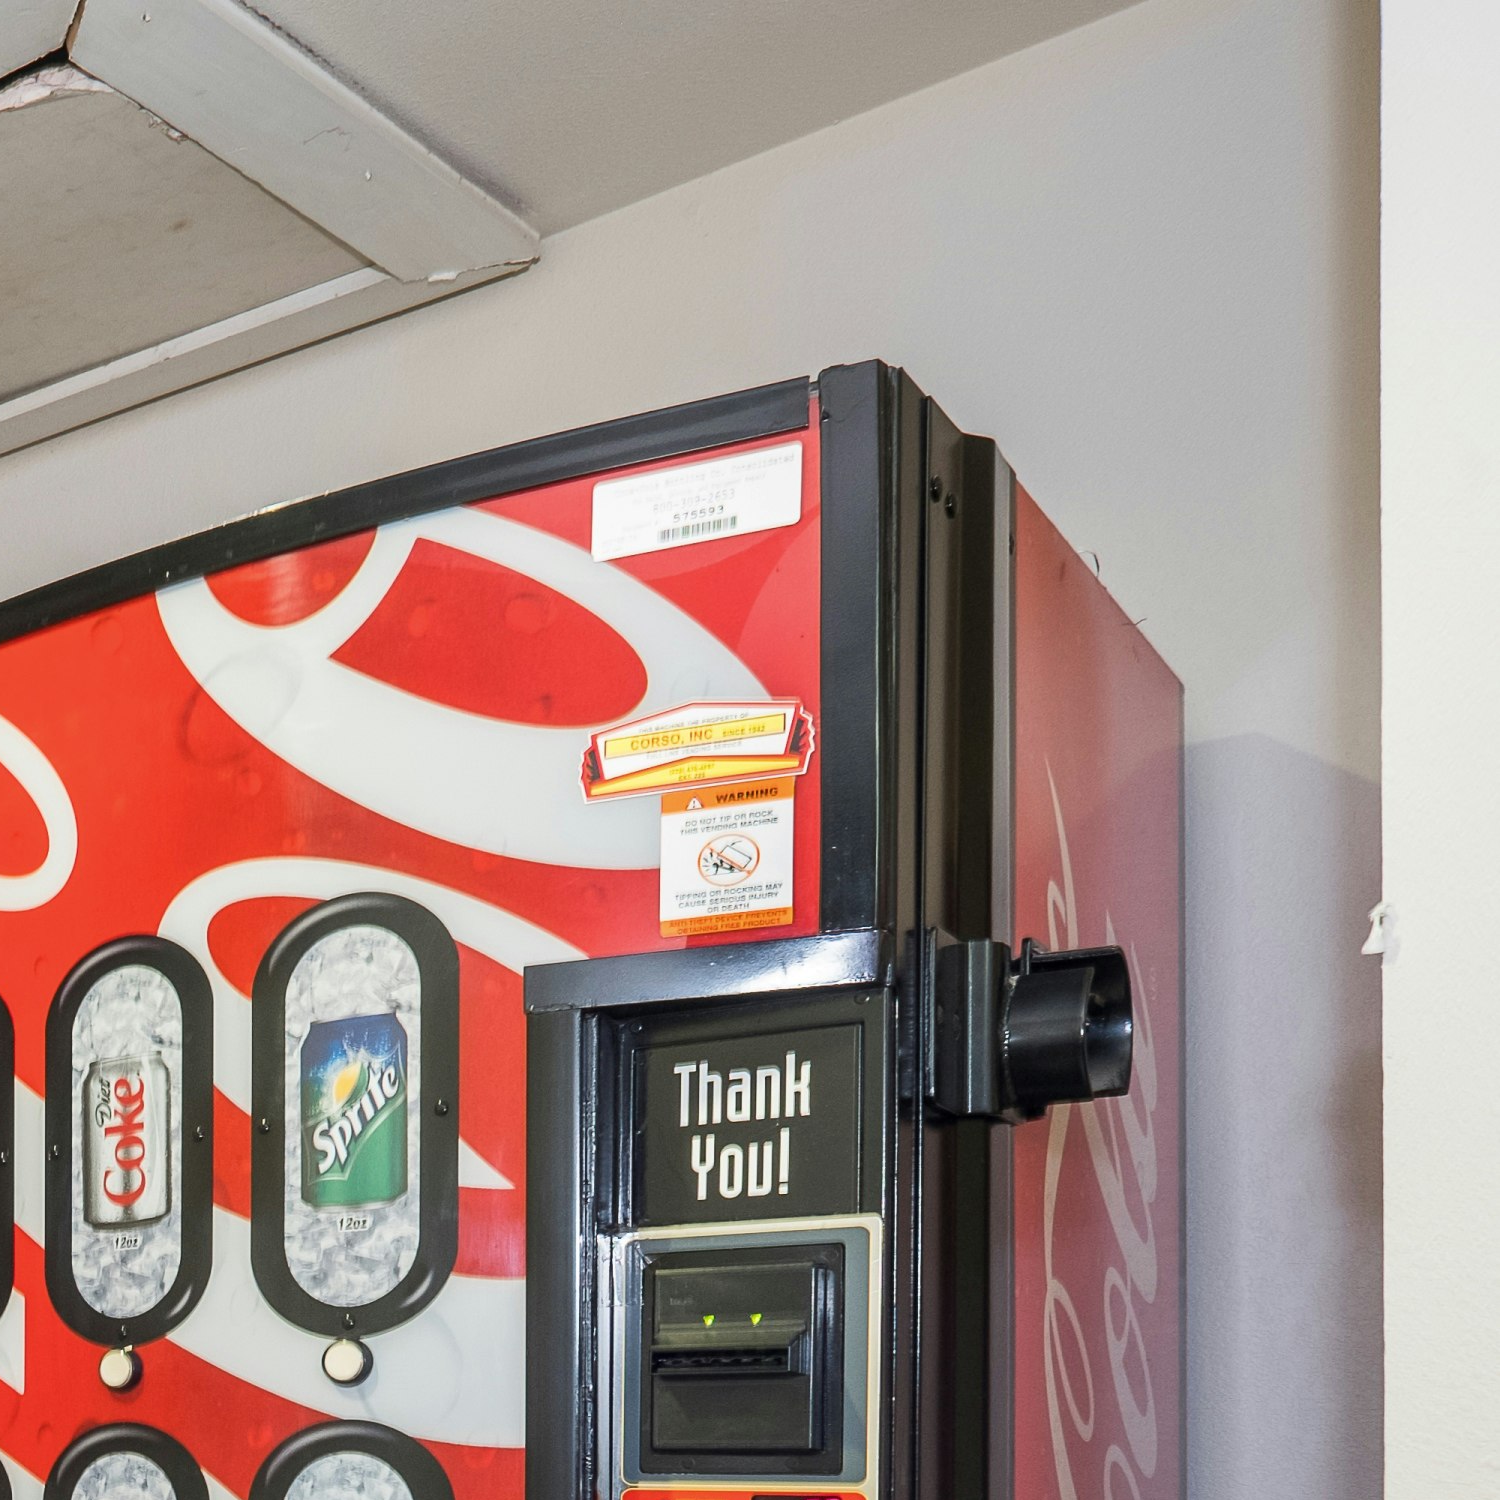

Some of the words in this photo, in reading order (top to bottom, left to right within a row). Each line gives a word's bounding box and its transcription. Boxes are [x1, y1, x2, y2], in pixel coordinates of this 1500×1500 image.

[673, 505, 725, 523] 575593
[631, 733, 684, 752] CORSO,
[689, 728, 714, 742] INC
[722, 726, 746, 738] SINCE
[716, 787, 779, 804] WARNING
[680, 827, 698, 836] THIS
[701, 822, 738, 834] VENDING
[741, 817, 779, 829] MACHINE
[685, 820, 698, 828] DO
[700, 817, 717, 826] NOT
[719, 815, 731, 824] TIP
[734, 812, 747, 821] OR
[749, 809, 774, 819] ROCK
[675, 889, 707, 901] TIPPING
[709, 888, 722, 898] OR
[724, 884, 763, 896] ROCKING
[765, 882, 784, 892] MAY
[678, 898, 706, 910] CAUSE
[709, 894, 746, 906] SERIOUS
[748, 890, 780, 901] INJURY
[707, 905, 720, 914] OR
[721, 902, 750, 913] DEATH
[715, 913, 743, 923] DEVICE
[745, 909, 788, 921] PREVENTS
[677, 924, 719, 936] OBTAINING
[743, 917, 782, 929] PRODUCT
[673, 1050, 811, 1127] Thank
[95, 1078, 112, 1128] Diet
[312, 1064, 399, 1174] Sprite
[103, 1077, 146, 1208] Coke
[691, 1127, 790, 1201] You!
[338, 1217, 369, 1231] 12oz
[114, 1236, 139, 1250] 12oz
